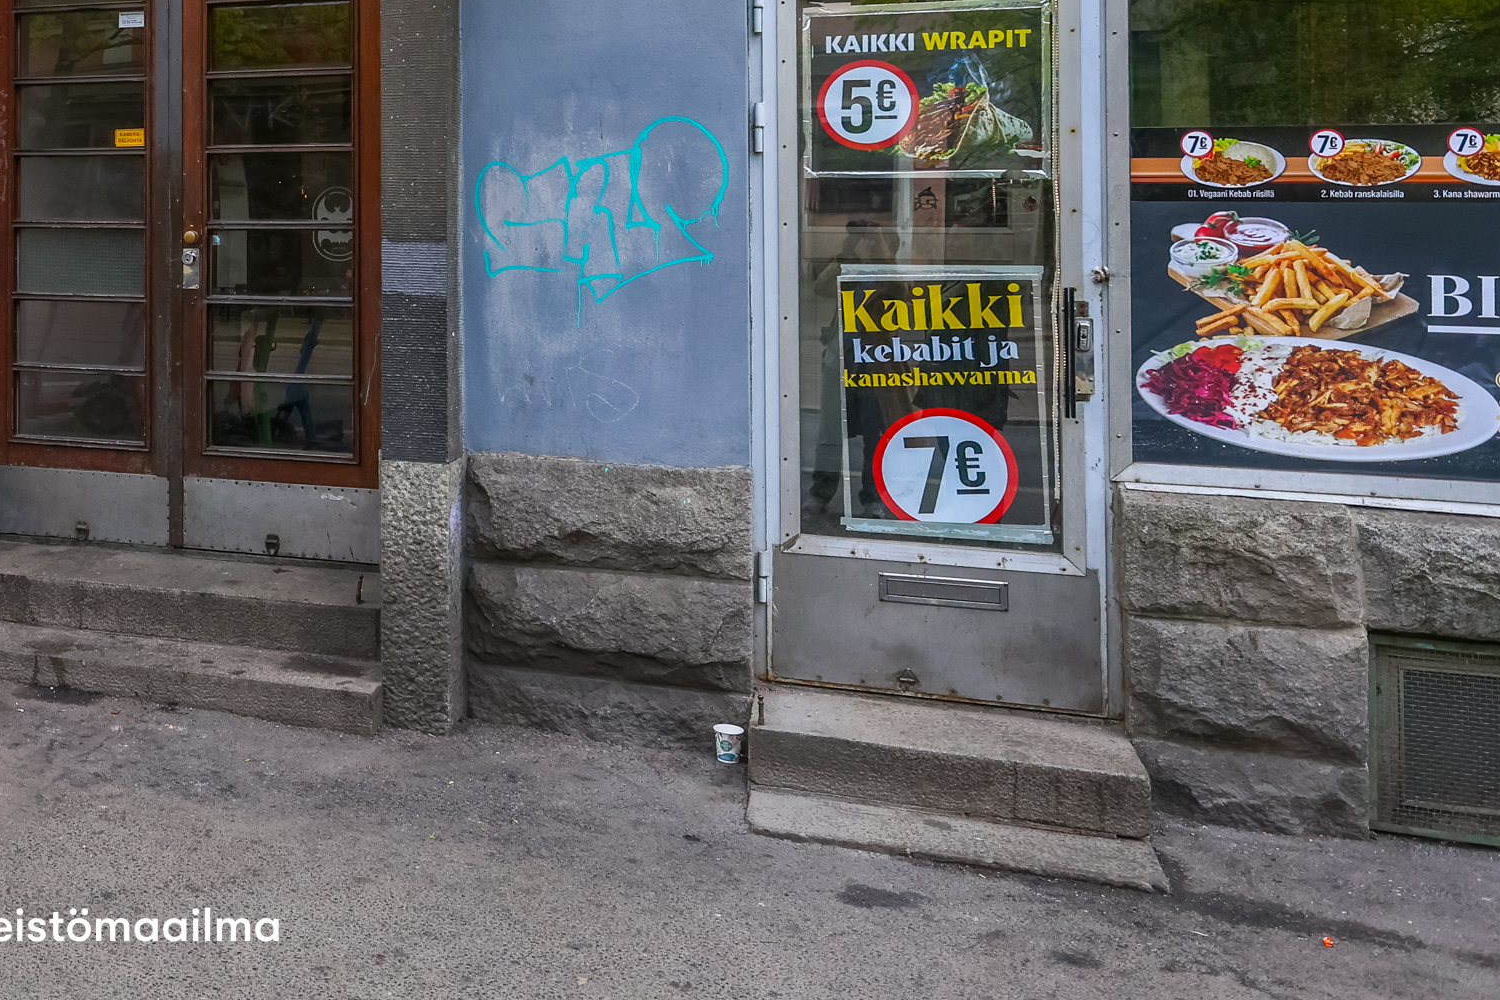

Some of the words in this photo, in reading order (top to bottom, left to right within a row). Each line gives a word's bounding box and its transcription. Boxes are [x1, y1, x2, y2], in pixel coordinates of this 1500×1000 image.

[825, 33, 915, 53] KAIKKI
[922, 29, 1032, 50] WRAPIT
[841, 79, 898, 134] 5€
[1187, 135, 1208, 154] 7€
[1317, 134, 1338, 154] 7€
[1456, 133, 1477, 153] 7€
[1187, 189, 1198, 198] 01.
[1200, 189, 1228, 199] Vegaani
[1229, 189, 1251, 198] Kebab
[1252, 189, 1275, 198] riisillä
[1321, 190, 1328, 198] 2.
[1329, 190, 1353, 198] Kebab
[1354, 190, 1404, 198] ranskalaisilla
[1433, 190, 1441, 198] 3.
[1442, 190, 1462, 198] Kana
[841, 283, 1025, 332] Kaikki
[852, 336, 975, 363] kebabit
[980, 335, 1020, 368] ja
[844, 367, 1037, 388] kanashawarma
[903, 435, 991, 515] 7€
